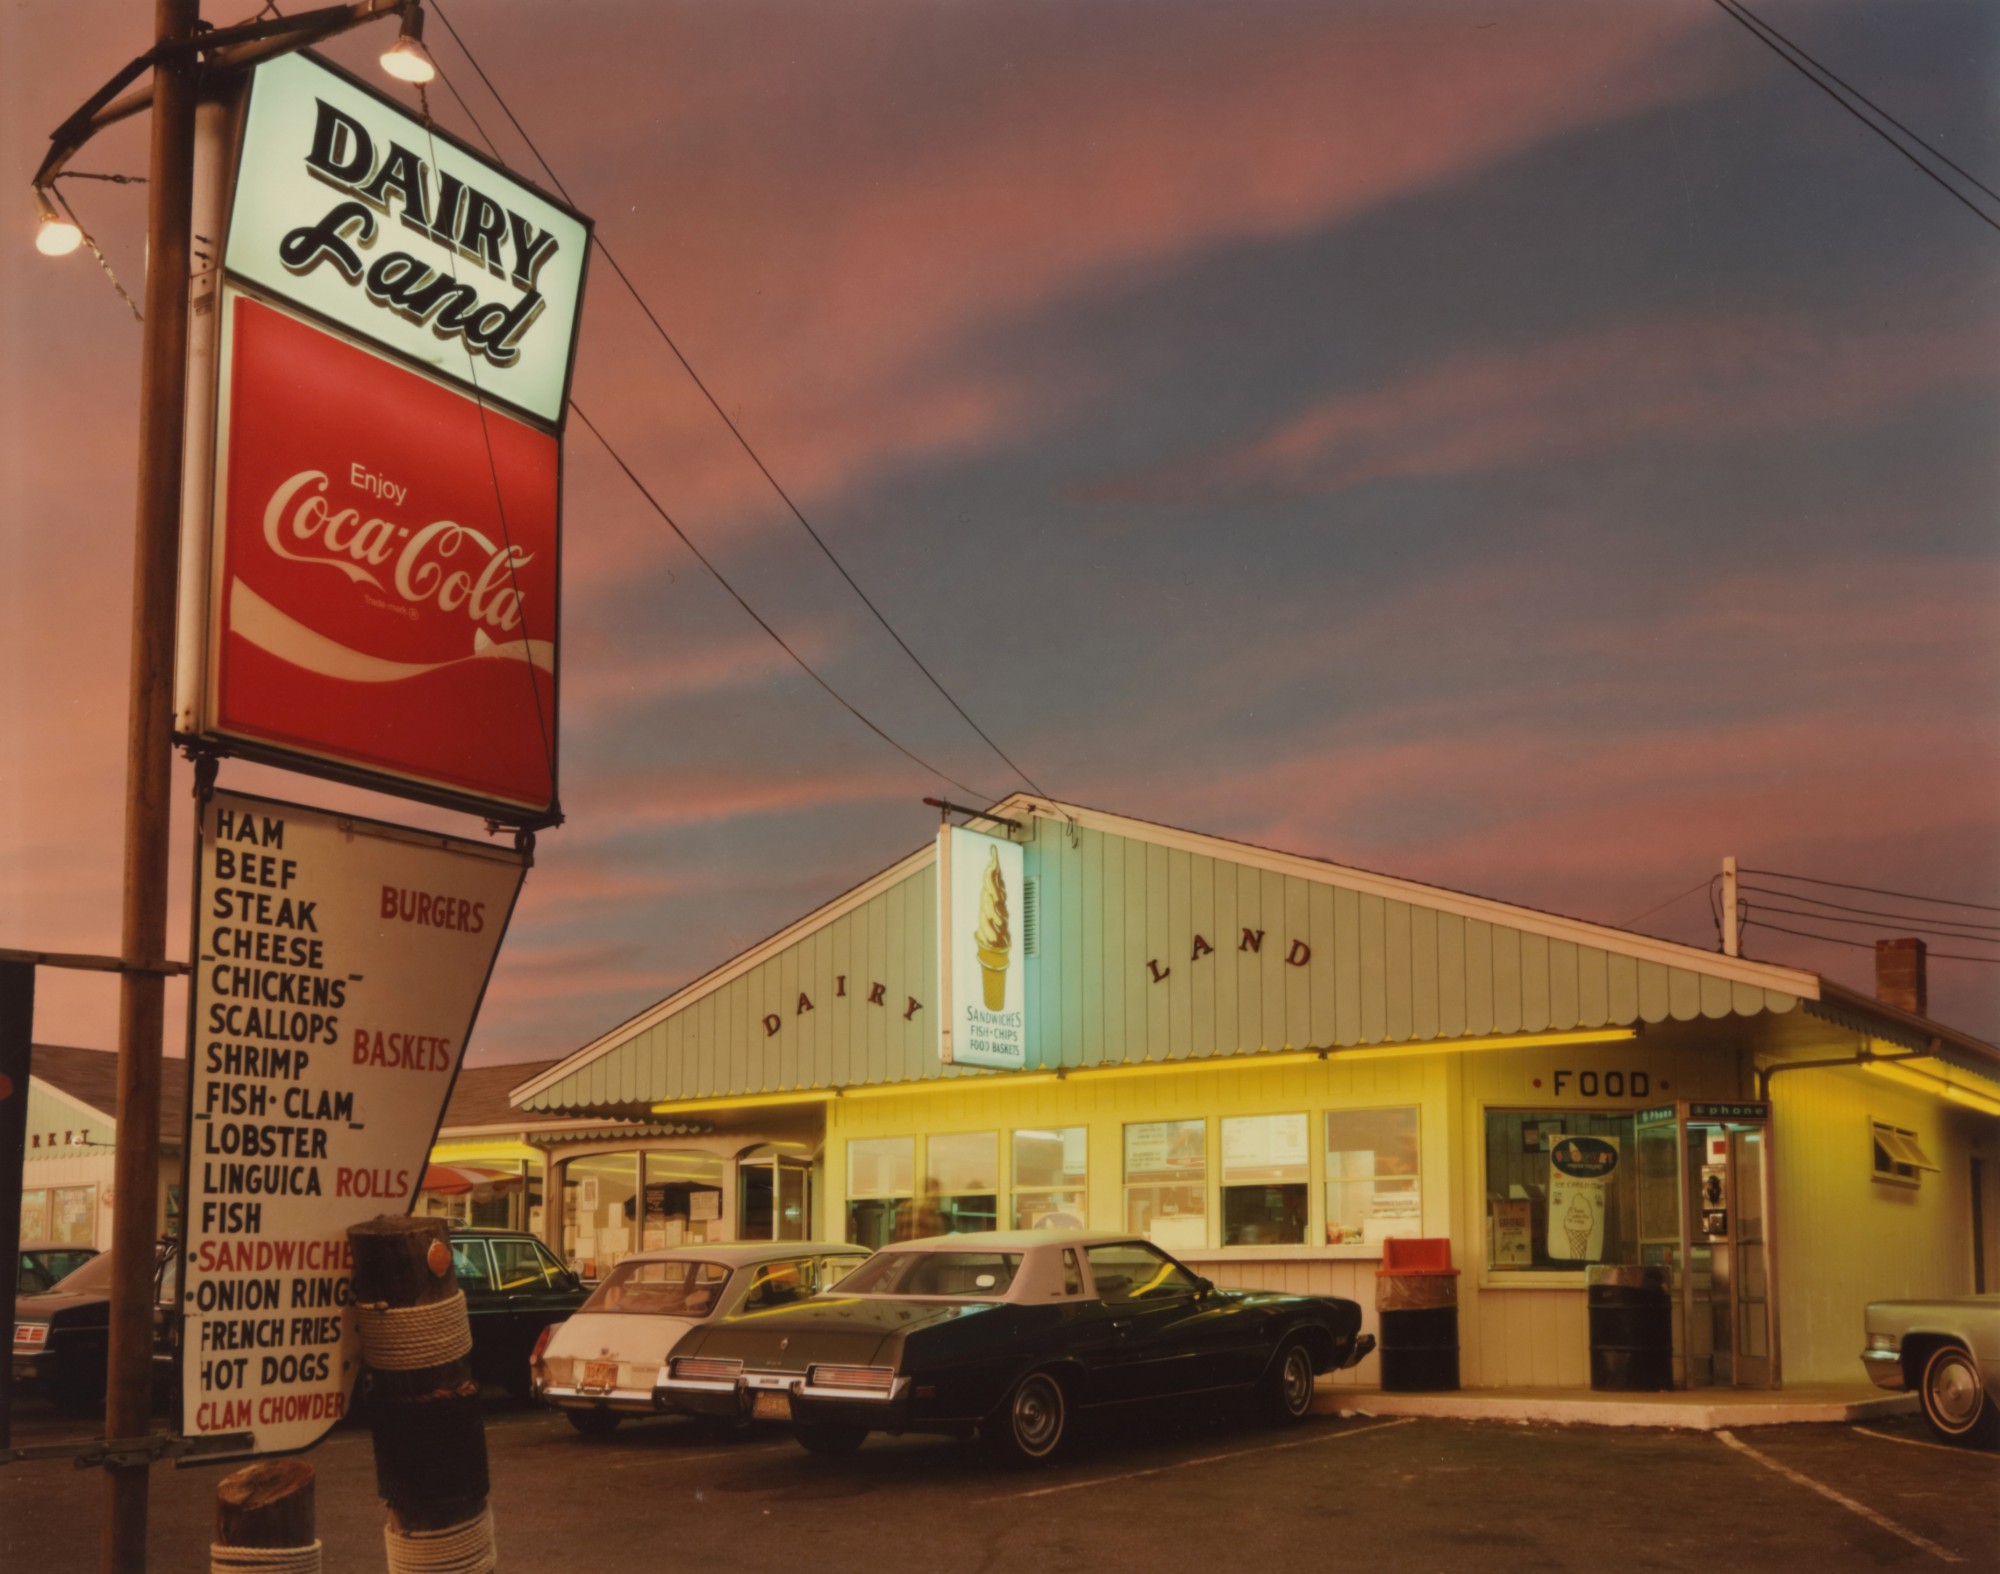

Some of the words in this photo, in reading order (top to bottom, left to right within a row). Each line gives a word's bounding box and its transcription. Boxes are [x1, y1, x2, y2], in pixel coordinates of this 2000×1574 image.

[304, 97, 559, 293] DAIRY
[279, 202, 546, 369] Land
[351, 463, 407, 506] Enjoy
[263, 470, 535, 631] Coca-Cola
[216, 808, 283, 848] HAM
[215, 848, 296, 888] BEEF
[213, 887, 316, 931] STEAK
[380, 885, 484, 932] BURGERS
[212, 926, 322, 968] CHEESE
[1147, 928, 1310, 981] LAND
[211, 964, 345, 1007] CHICKENS
[763, 976, 920, 1035] DAIRY
[208, 1003, 337, 1043] SCALLOPS
[967, 1006, 1021, 1027] SANDWICHES
[206, 1042, 307, 1079] SHRIMP
[352, 1028, 449, 1070] BASKETS
[971, 1040, 989, 1051] FOOD
[993, 1043, 1019, 1055] BASKETS
[1553, 1071, 1650, 1098] FOOD
[1709, 1105, 1764, 1116] phone
[205, 1122, 326, 1158] LOBSTER
[203, 1163, 320, 1196] LINGUICA
[335, 1167, 407, 1198] ROLLS
[202, 1202, 260, 1233] FISH
[197, 1240, 351, 1272] SANDWICHE
[196, 1279, 279, 1311] ONION
[291, 1277, 353, 1307] RING
[201, 1319, 283, 1350] FRENCH
[290, 1316, 340, 1345] FRIES
[201, 1358, 247, 1390] HOT
[260, 1352, 328, 1385] DOGS
[196, 1402, 251, 1431] CLAM
[258, 1392, 343, 1424] CHOWDER
